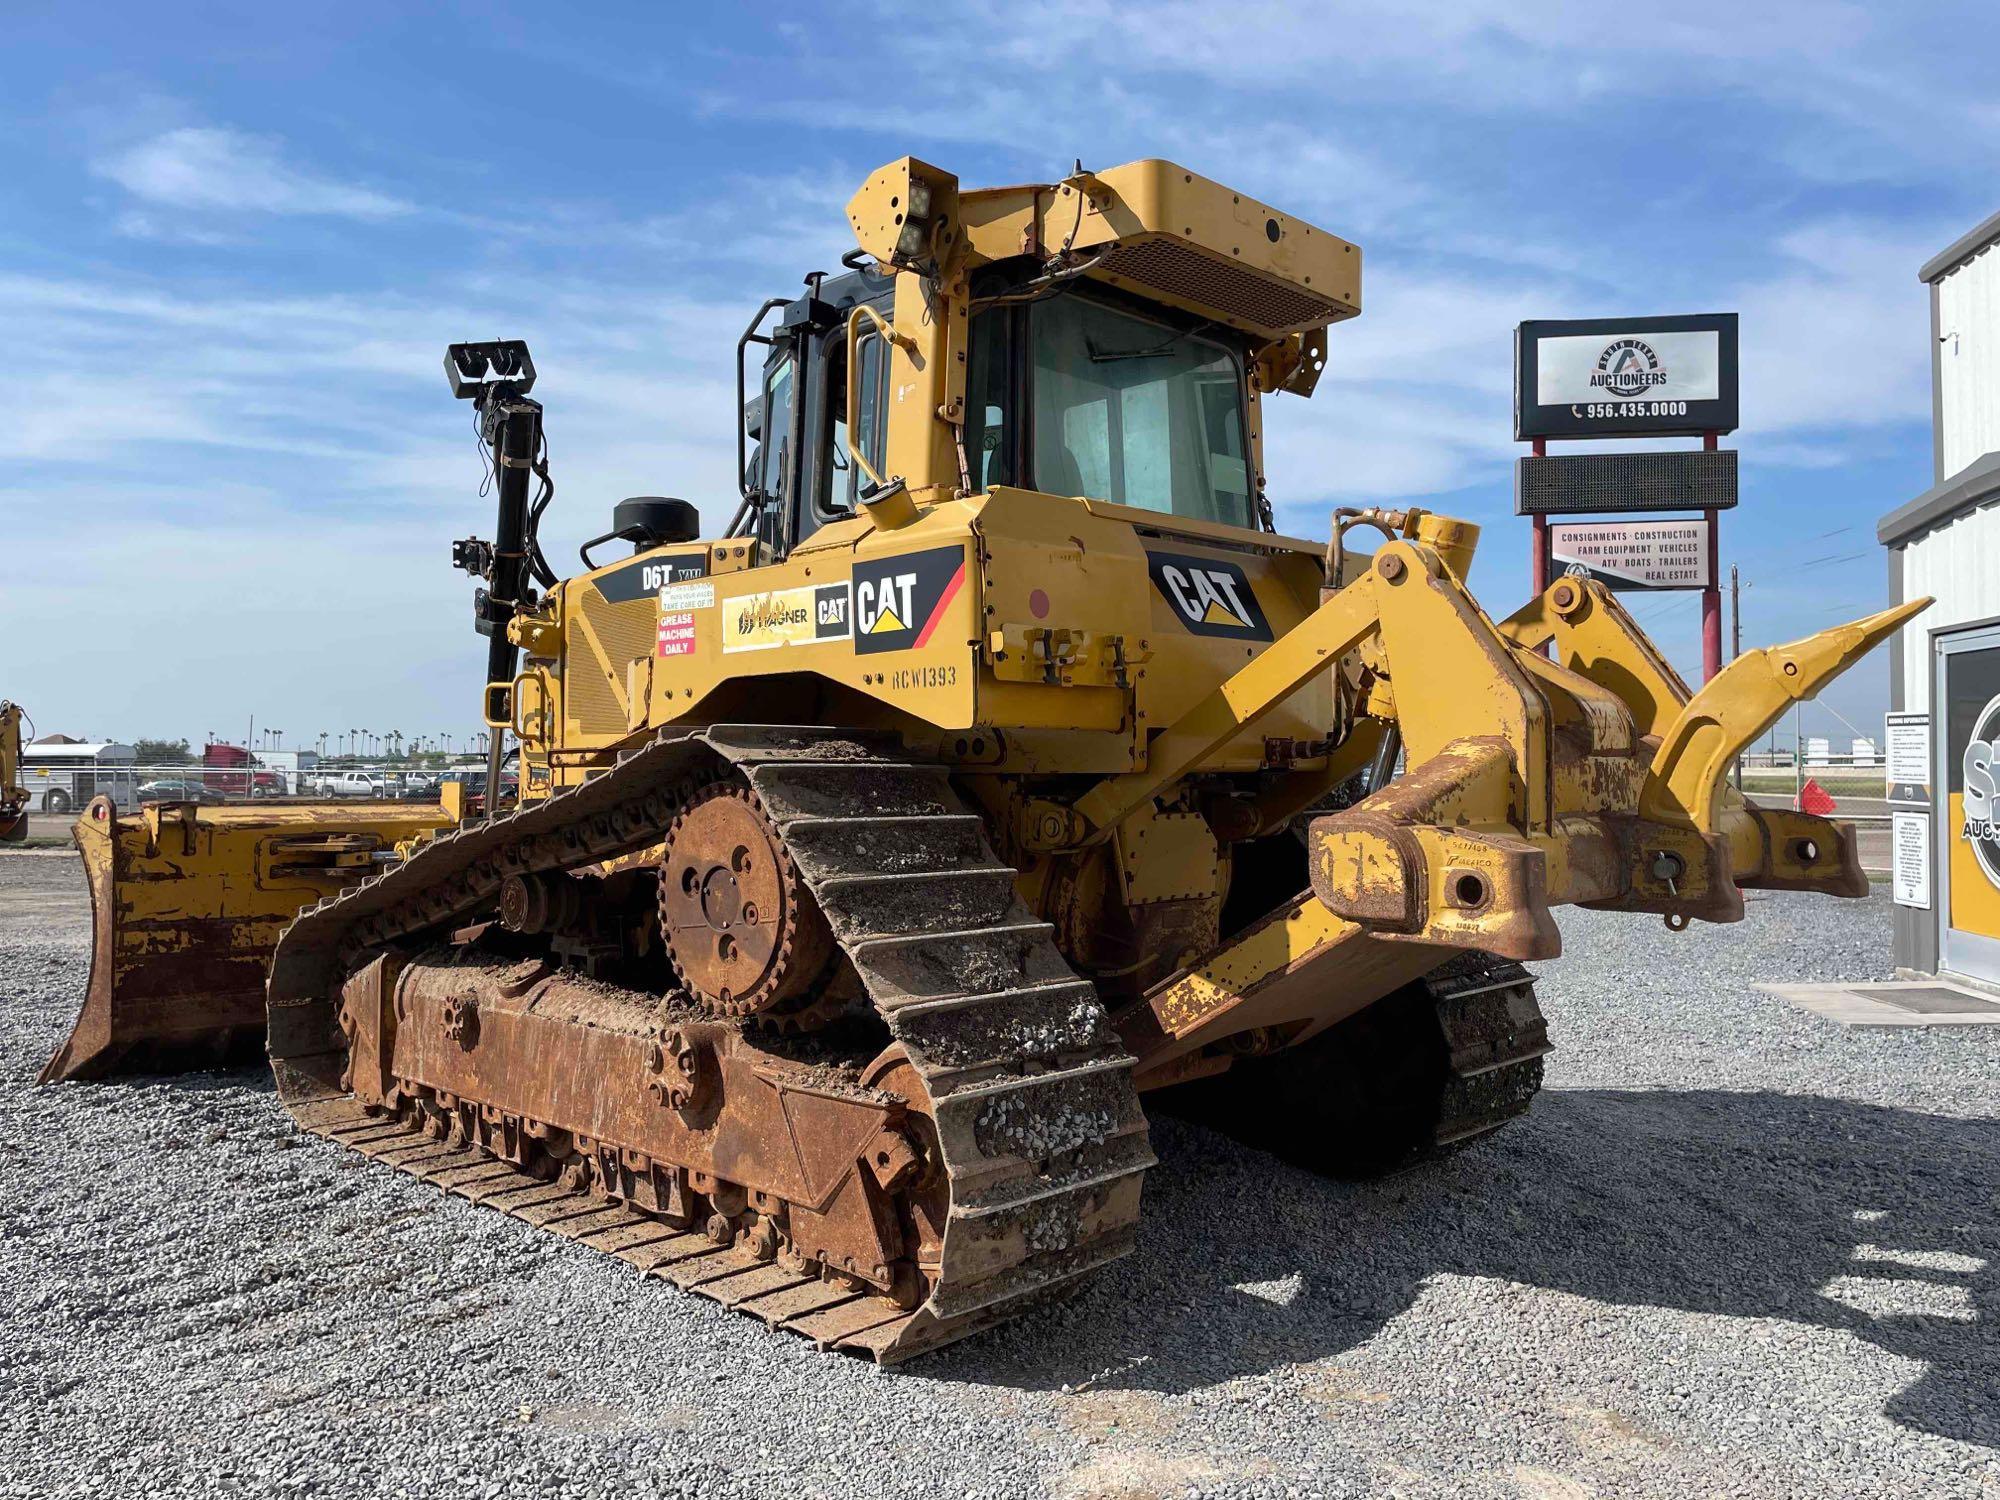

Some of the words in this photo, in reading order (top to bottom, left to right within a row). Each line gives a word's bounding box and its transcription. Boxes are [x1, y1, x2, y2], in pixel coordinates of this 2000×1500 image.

[1600, 340, 1625, 365] SOUTH
[1632, 340, 1658, 363] TEXAS
[1590, 372, 1667, 387] AUCTIONEERS
[1587, 401, 1687, 419] 956.435.0000
[1561, 532, 1627, 542] CONSIGNMENTS
[1634, 530, 1698, 540] CONSTRUCTION
[1577, 546, 1600, 555] FARM
[1603, 544, 1651, 555] EQUIPMENT
[1659, 543, 1698, 553] VEHICLES
[1601, 559, 1617, 567] ATV
[1625, 558, 1651, 567] BOATS
[1659, 557, 1698, 566] TRAILERS
[643, 564, 673, 591] D6T
[1645, 571, 1666, 580] REAL
[1669, 570, 1698, 579] ESTATE
[1162, 564, 1255, 628] CAT
[663, 602, 678, 610] TAKE
[680, 601, 696, 609] CARE
[697, 599, 706, 607] OF
[857, 573, 917, 635] CAT
[817, 598, 847, 625] CAT
[660, 613, 692, 627] GREASE
[659, 627, 695, 641] MACHINE
[665, 642, 688, 655] DAILY
[893, 666, 956, 690] RCW1393
